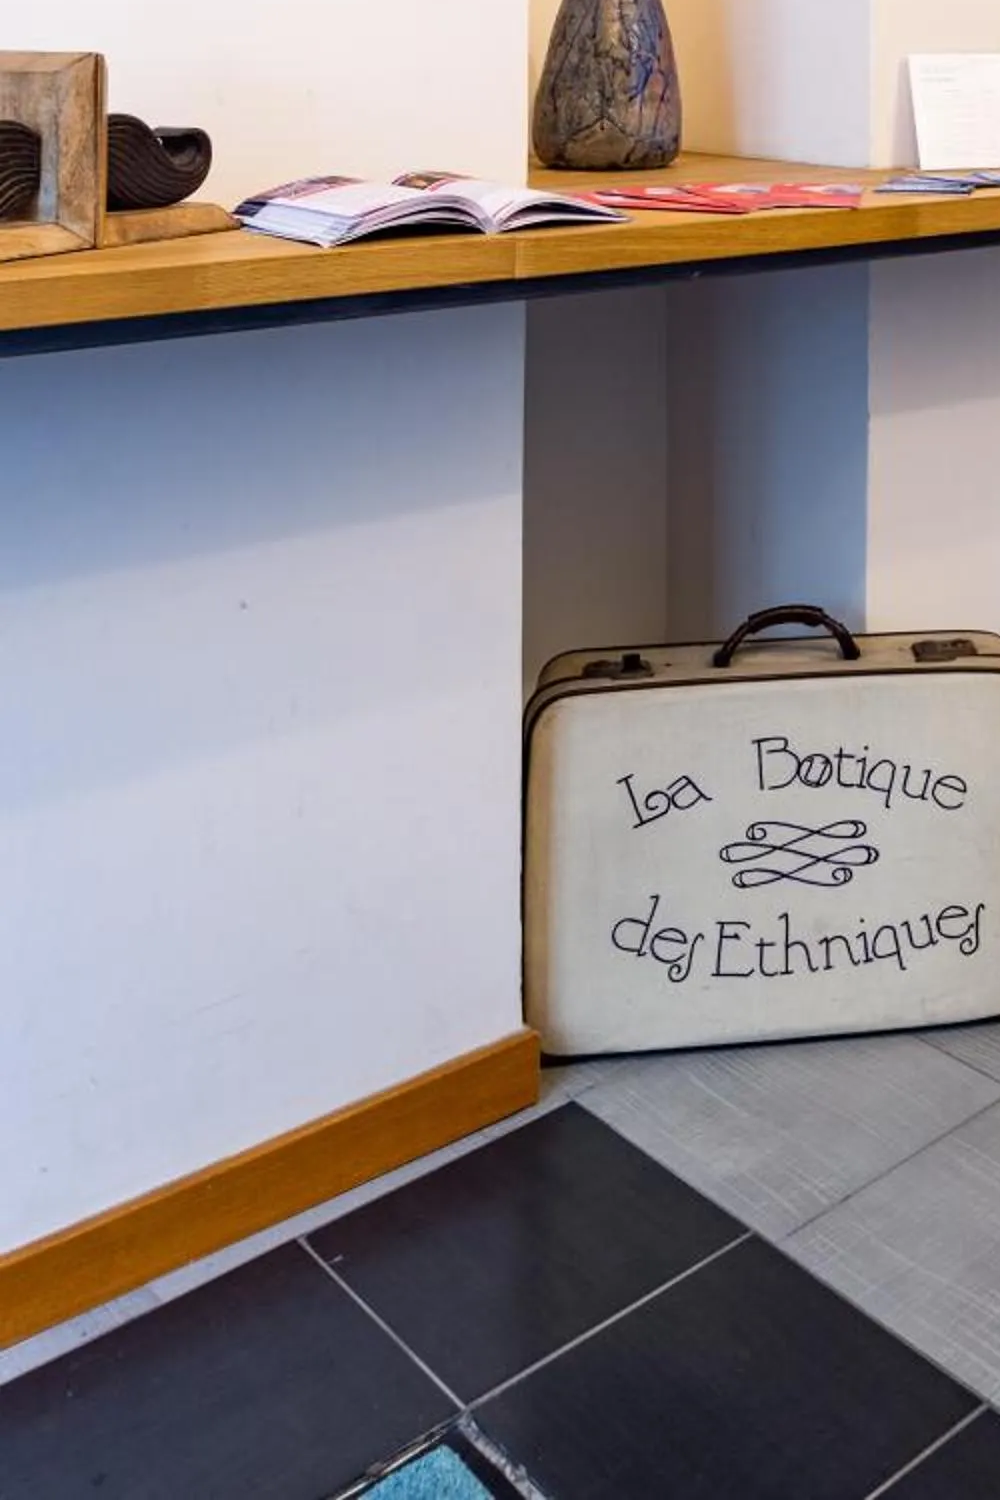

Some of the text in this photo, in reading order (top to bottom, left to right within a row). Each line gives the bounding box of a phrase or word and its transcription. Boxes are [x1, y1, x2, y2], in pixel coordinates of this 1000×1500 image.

[616, 773, 713, 829] La
[611, 894, 985, 982] des Ethniques
